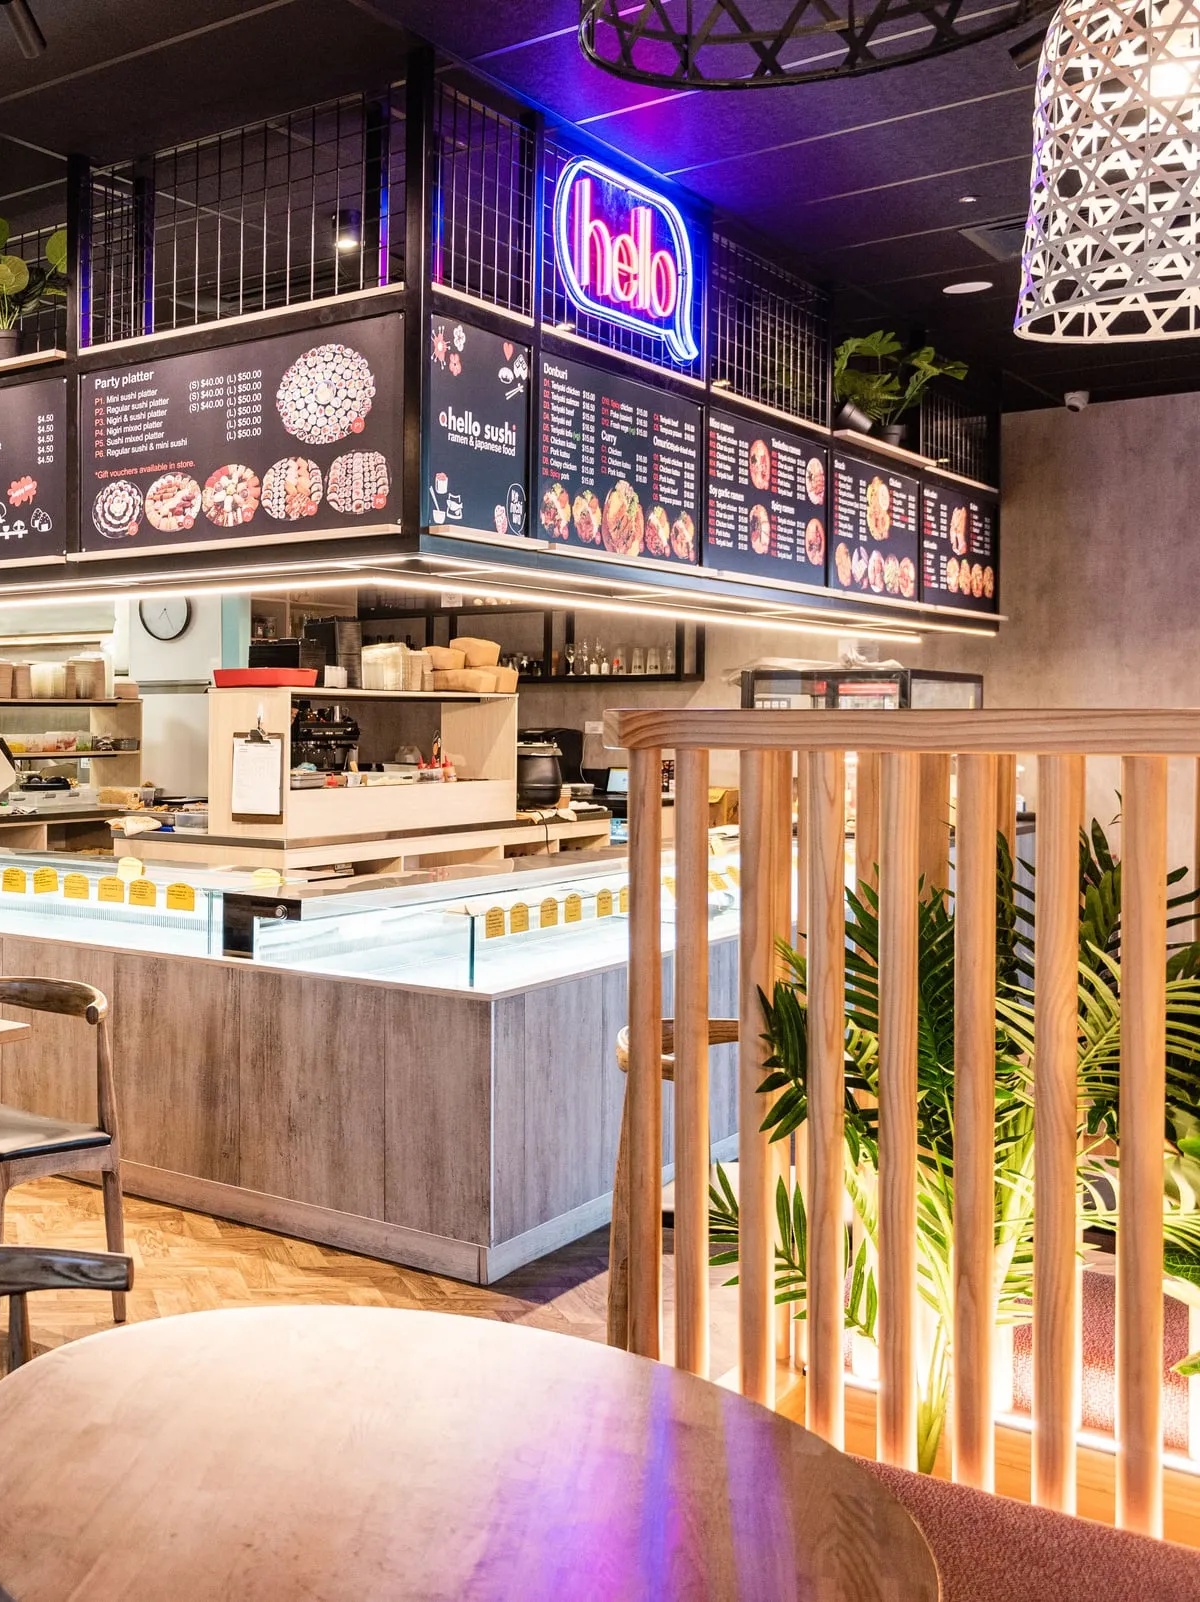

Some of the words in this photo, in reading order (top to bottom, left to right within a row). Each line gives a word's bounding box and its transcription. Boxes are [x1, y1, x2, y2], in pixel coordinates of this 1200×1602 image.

[575, 178, 677, 317] hello
[95, 376, 120, 389] Party
[122, 371, 154, 386] platter
[544, 362, 567, 380] Donburi
[106, 395, 119, 404] Mini
[120, 392, 136, 401] sushi
[138, 389, 158, 399] platter
[189, 380, 199, 391] (S)
[201, 376, 223, 388] $40.00
[226, 374, 236, 385] (L)
[238, 370, 262, 381] $50.00
[106, 404, 130, 414] Regular
[131, 401, 148, 410] sushi
[149, 398, 169, 408] platter
[189, 391, 199, 402] (S)
[201, 387, 223, 399] $40.00
[226, 385, 236, 396] (L)
[238, 381, 262, 393] $50.00
[37, 414, 54, 424] $4.50
[106, 416, 122, 425] Nigiri
[123, 414, 128, 422] &
[129, 411, 146, 421] sushi
[147, 408, 167, 418] platter
[189, 403, 199, 413] (S)
[201, 399, 223, 410] $40.00
[226, 397, 236, 407] (L)
[238, 393, 262, 404] $50.00
[37, 424, 54, 434] $4.50
[106, 426, 122, 436] Nigiri
[123, 423, 141, 433] mixed
[143, 420, 163, 431] platter
[226, 408, 236, 419] (L)
[238, 404, 262, 416] $50.00
[448, 406, 480, 436] hello
[484, 422, 516, 446] sushi
[37, 434, 54, 444] $4.50
[106, 437, 123, 446] Sushi
[124, 434, 143, 443] mixed
[144, 431, 164, 441] platter
[226, 420, 236, 430] (L)
[238, 416, 262, 427] $50.00
[601, 430, 617, 446] Curry
[37, 445, 54, 455] $4.50
[106, 447, 130, 457] Regular
[131, 443, 148, 453] sushi
[149, 442, 154, 451] &
[156, 440, 169, 449] mini
[170, 438, 187, 447] sushi
[226, 431, 236, 441] (L)
[238, 427, 262, 438] $50.00
[448, 432, 468, 445] ramen
[469, 436, 474, 446] &
[475, 438, 502, 454] japanese
[502, 445, 516, 456] food
[37, 455, 54, 465] $4.50
[110, 466, 138, 477] vouchers
[139, 463, 168, 474] available
